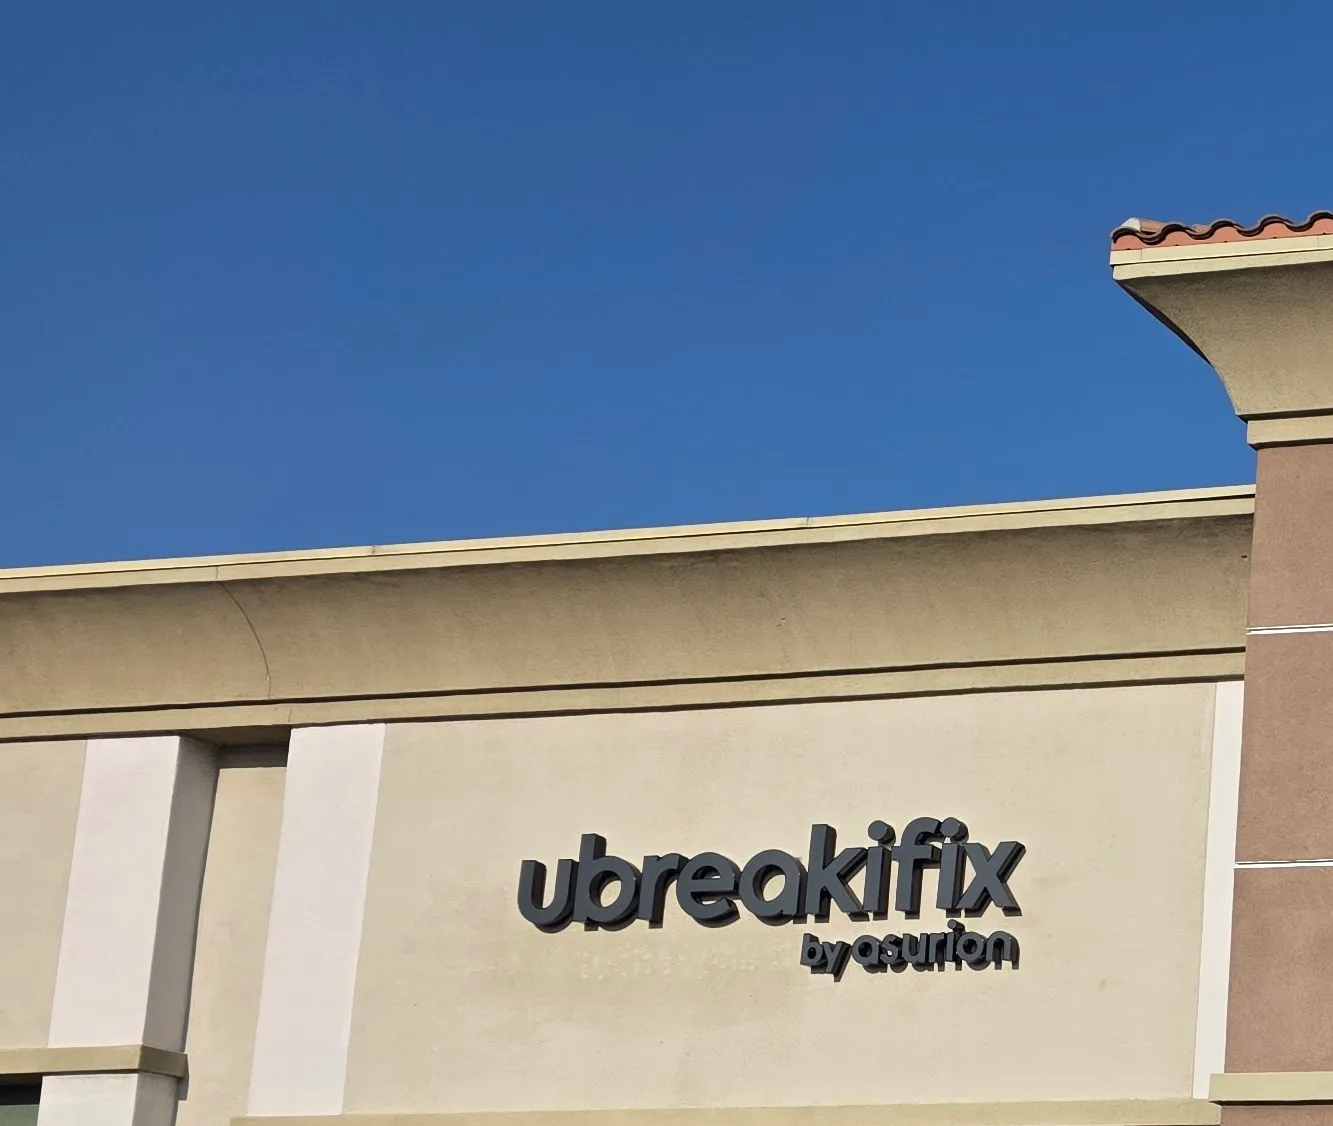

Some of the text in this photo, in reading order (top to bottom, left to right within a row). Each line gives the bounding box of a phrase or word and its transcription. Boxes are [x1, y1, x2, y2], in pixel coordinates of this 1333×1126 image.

[518, 817, 1026, 933] ubreakifix
[801, 920, 1019, 982] by asurion
